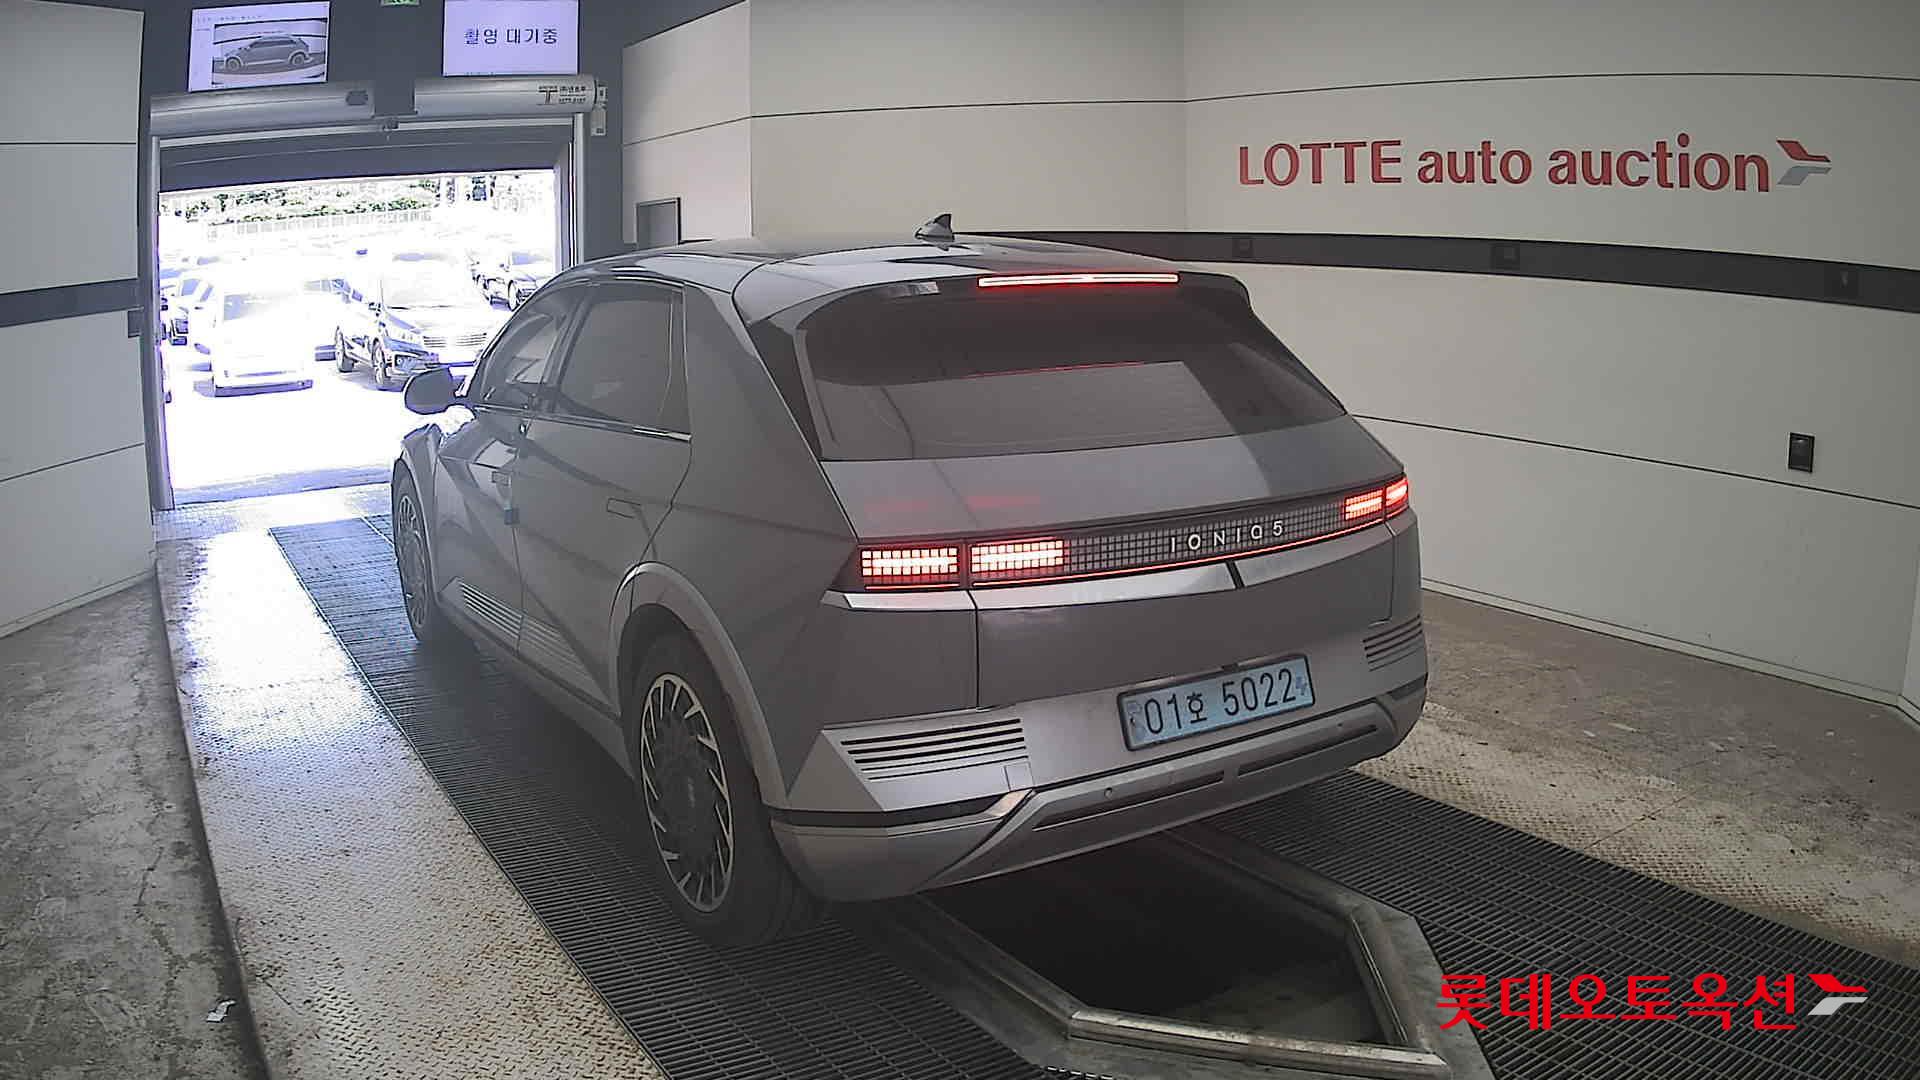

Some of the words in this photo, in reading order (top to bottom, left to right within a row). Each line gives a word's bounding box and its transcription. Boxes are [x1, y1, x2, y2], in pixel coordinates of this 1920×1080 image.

[506, 27, 558, 45] 대기중
[1239, 139, 1402, 187] LOTTE
[1417, 141, 1533, 186] auto
[1548, 133, 1770, 193] auction
[1171, 524, 1263, 553] IONIQ
[1272, 520, 1284, 537] 5
[1144, 691, 1208, 735] 01호
[1222, 668, 1297, 716] 5022
